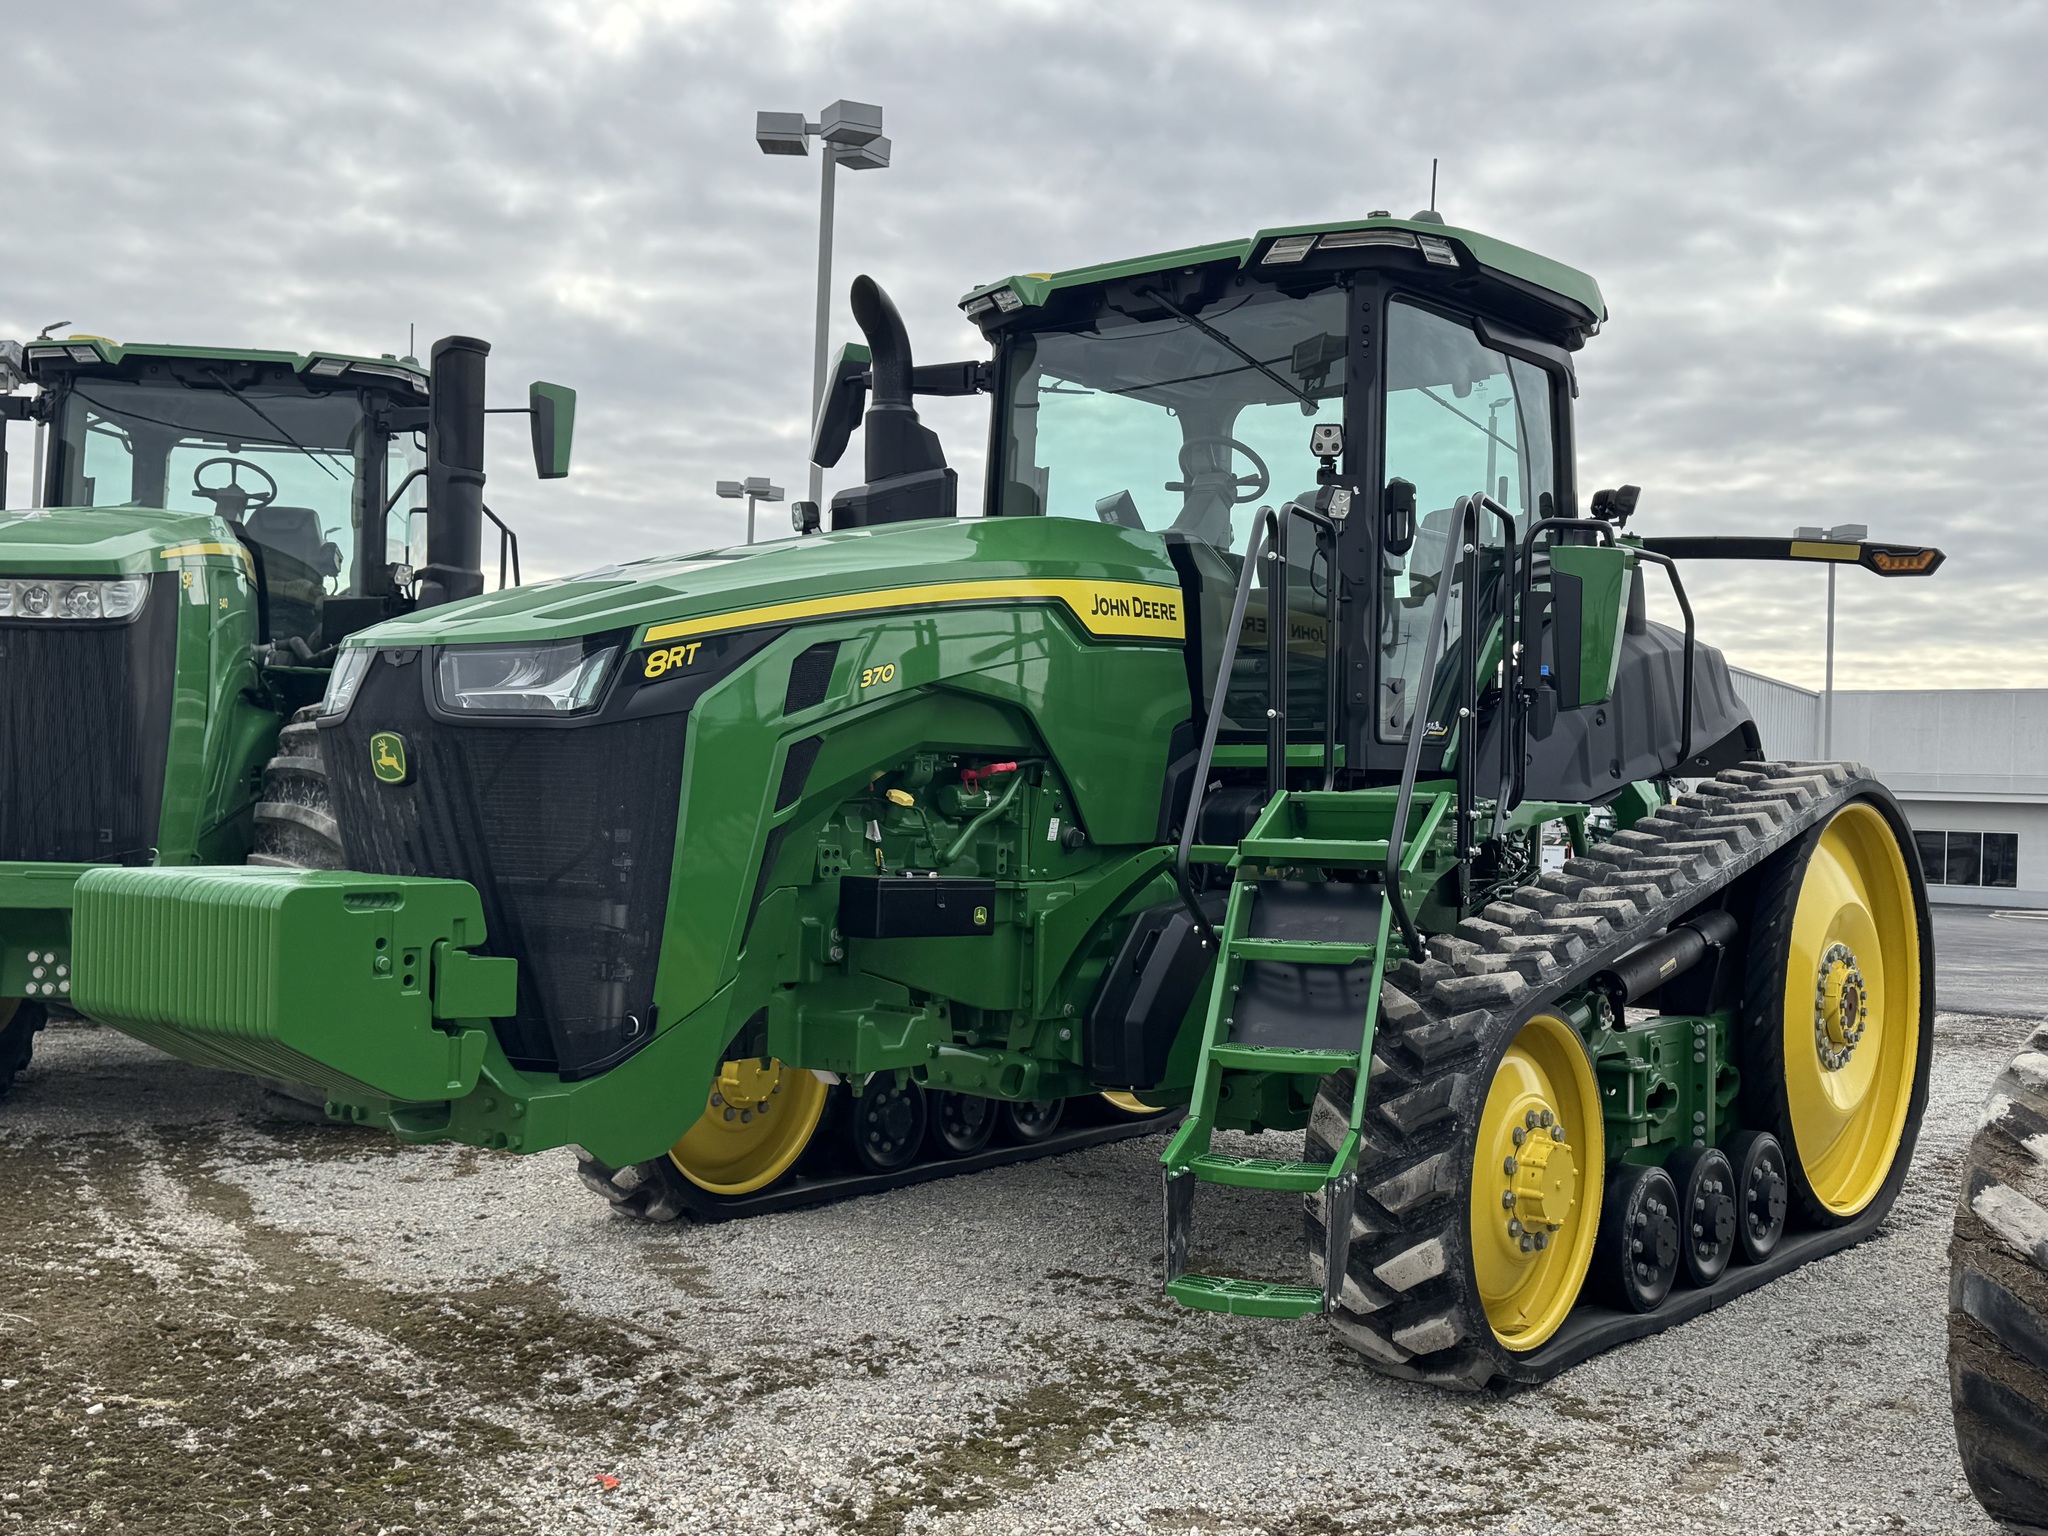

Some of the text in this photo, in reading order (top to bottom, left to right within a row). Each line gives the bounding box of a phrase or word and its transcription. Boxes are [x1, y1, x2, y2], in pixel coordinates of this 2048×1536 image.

[219, 597, 229, 610] 540
[1091, 593, 1177, 621] JOHN DEERE
[644, 642, 702, 678] 8RT
[860, 663, 895, 688] 370
